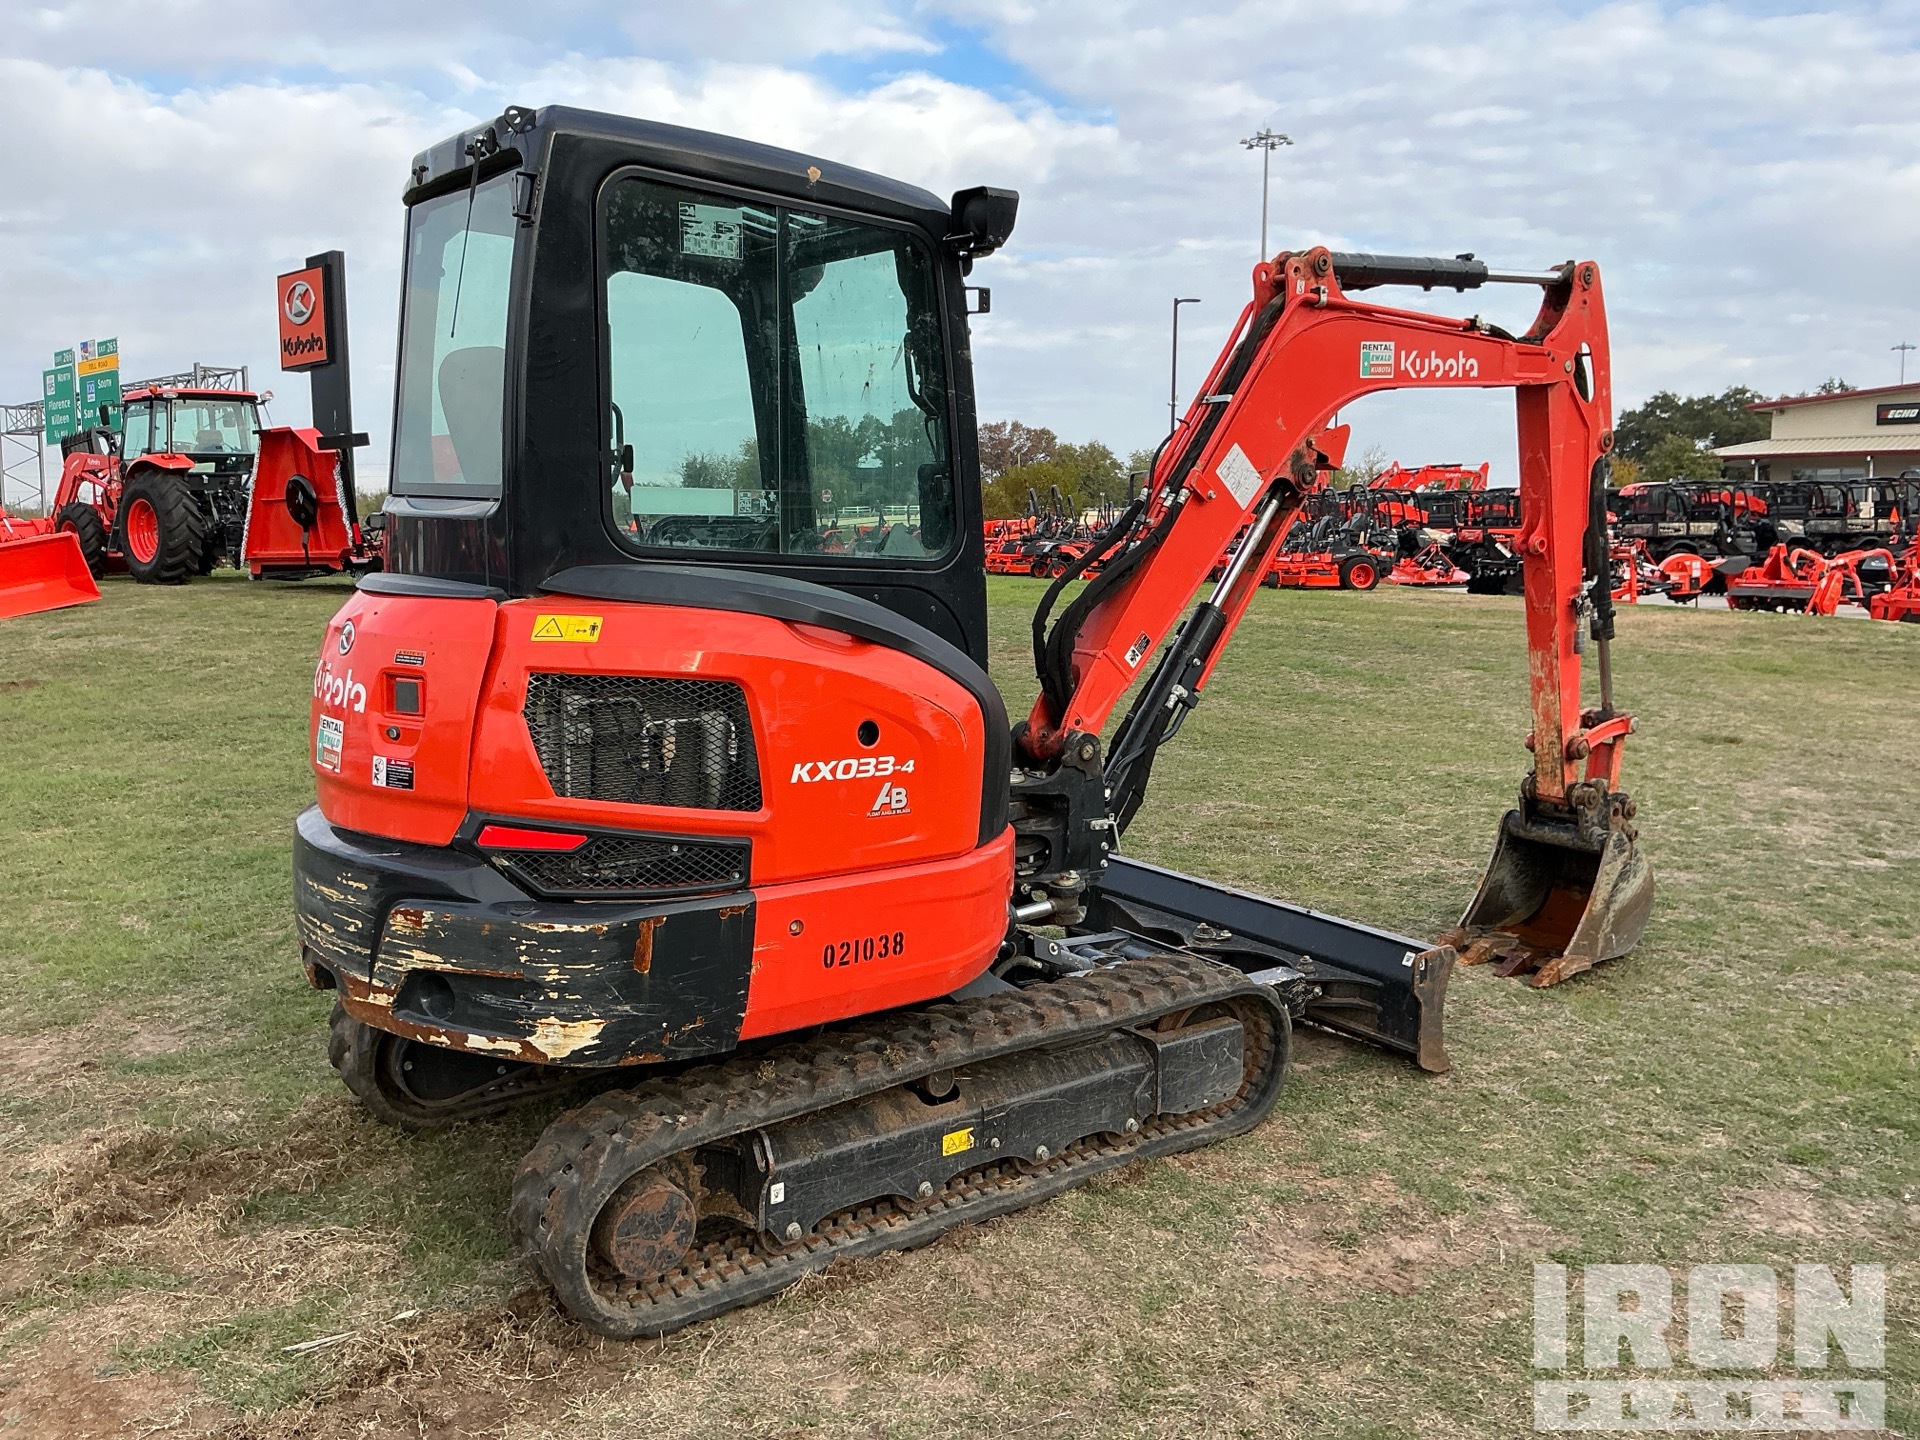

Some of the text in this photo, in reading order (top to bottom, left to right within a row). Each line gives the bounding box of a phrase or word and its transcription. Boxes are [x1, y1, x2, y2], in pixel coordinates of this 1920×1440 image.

[283, 333, 324, 356] Kubota
[1371, 354, 1392, 362] EWALD
[1400, 350, 1478, 378] Kubota
[49, 400, 70, 410] Florence
[84, 409, 93, 418] San
[1888, 409, 1919, 418] ECHO
[52, 414, 69, 425] Killeen
[790, 755, 915, 784] KX033-4
[871, 781, 909, 811] AB
[866, 810, 881, 818] FLOAT
[823, 932, 905, 969] 021038
